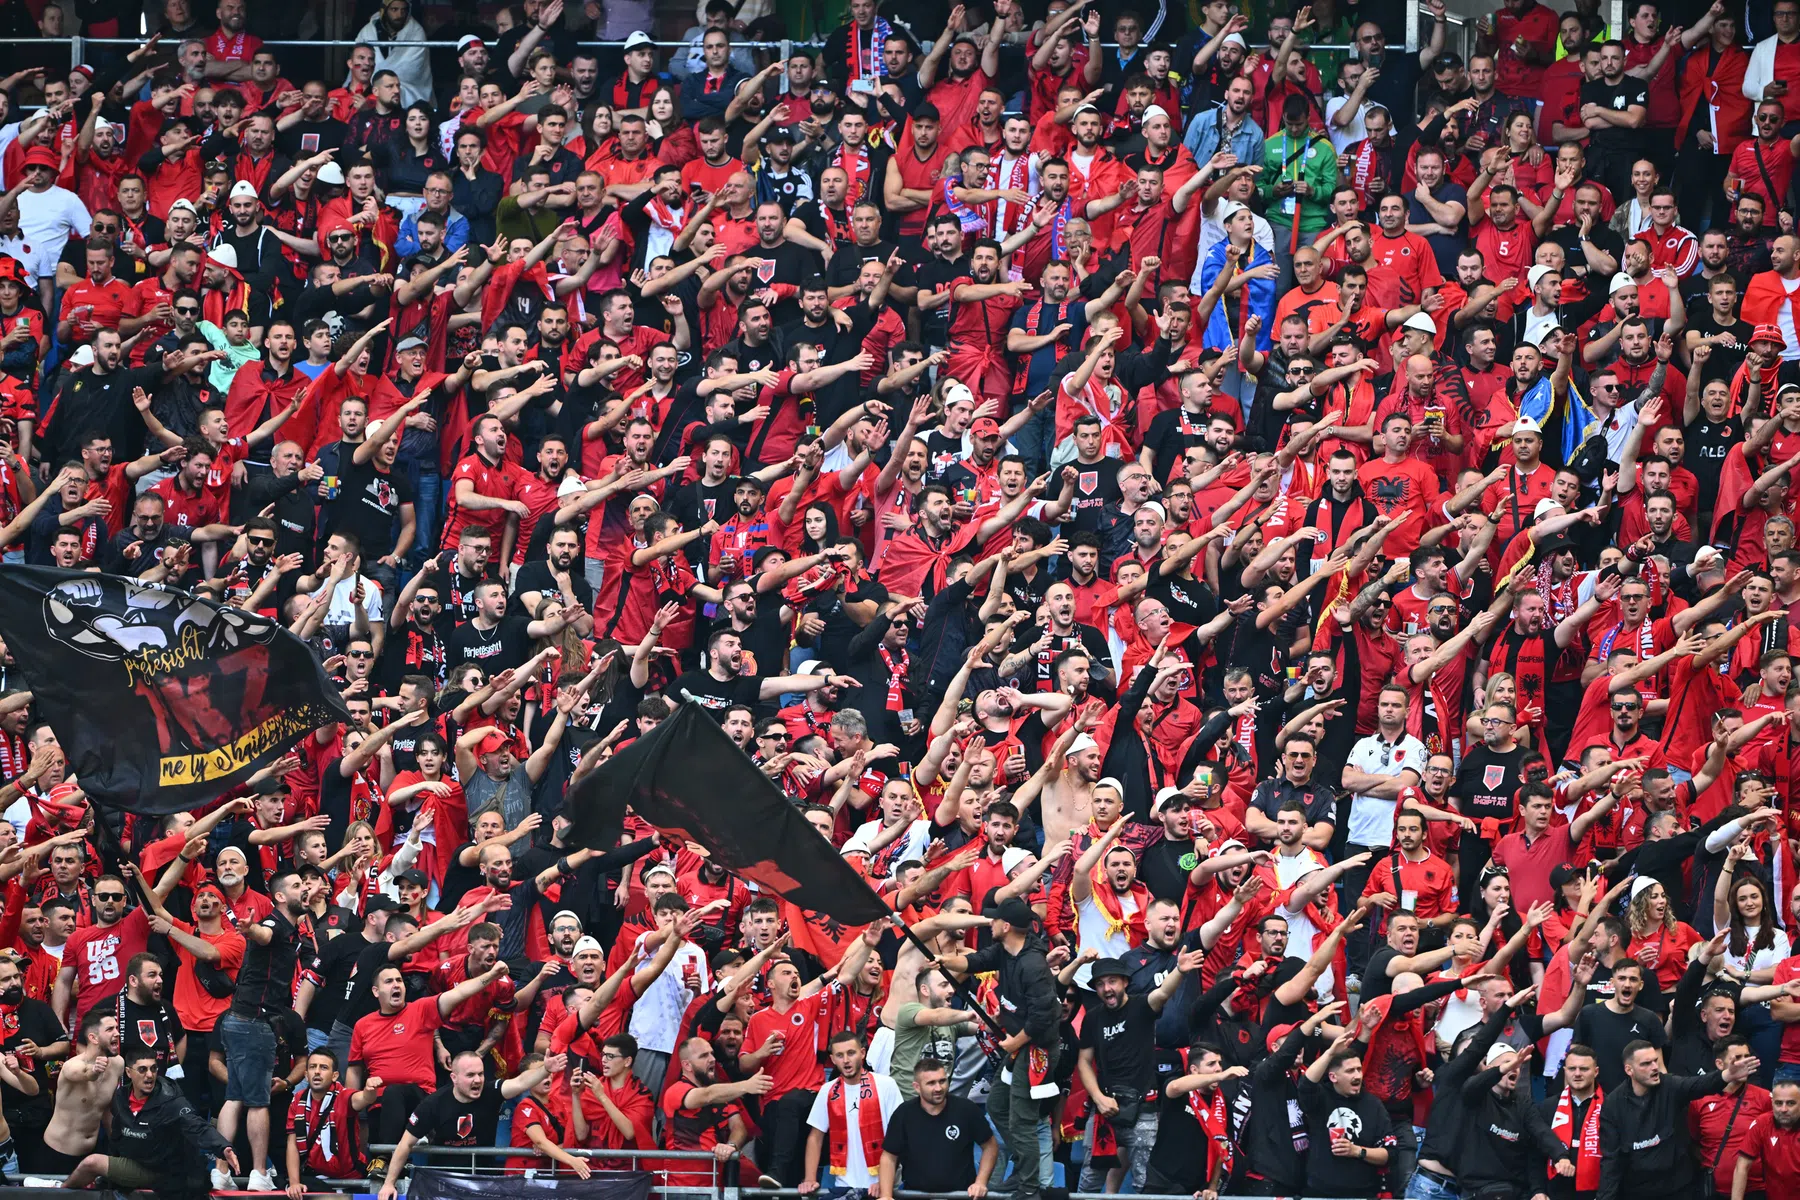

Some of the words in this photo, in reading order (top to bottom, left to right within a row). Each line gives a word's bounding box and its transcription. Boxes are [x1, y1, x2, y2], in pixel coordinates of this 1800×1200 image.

[1498, 241, 1509, 256] 5
[517, 296, 530, 314] 14
[1699, 445, 1726, 458] ALB
[208, 470, 222, 487] 14
[178, 513, 188, 526] 19
[89, 956, 120, 985] 99
